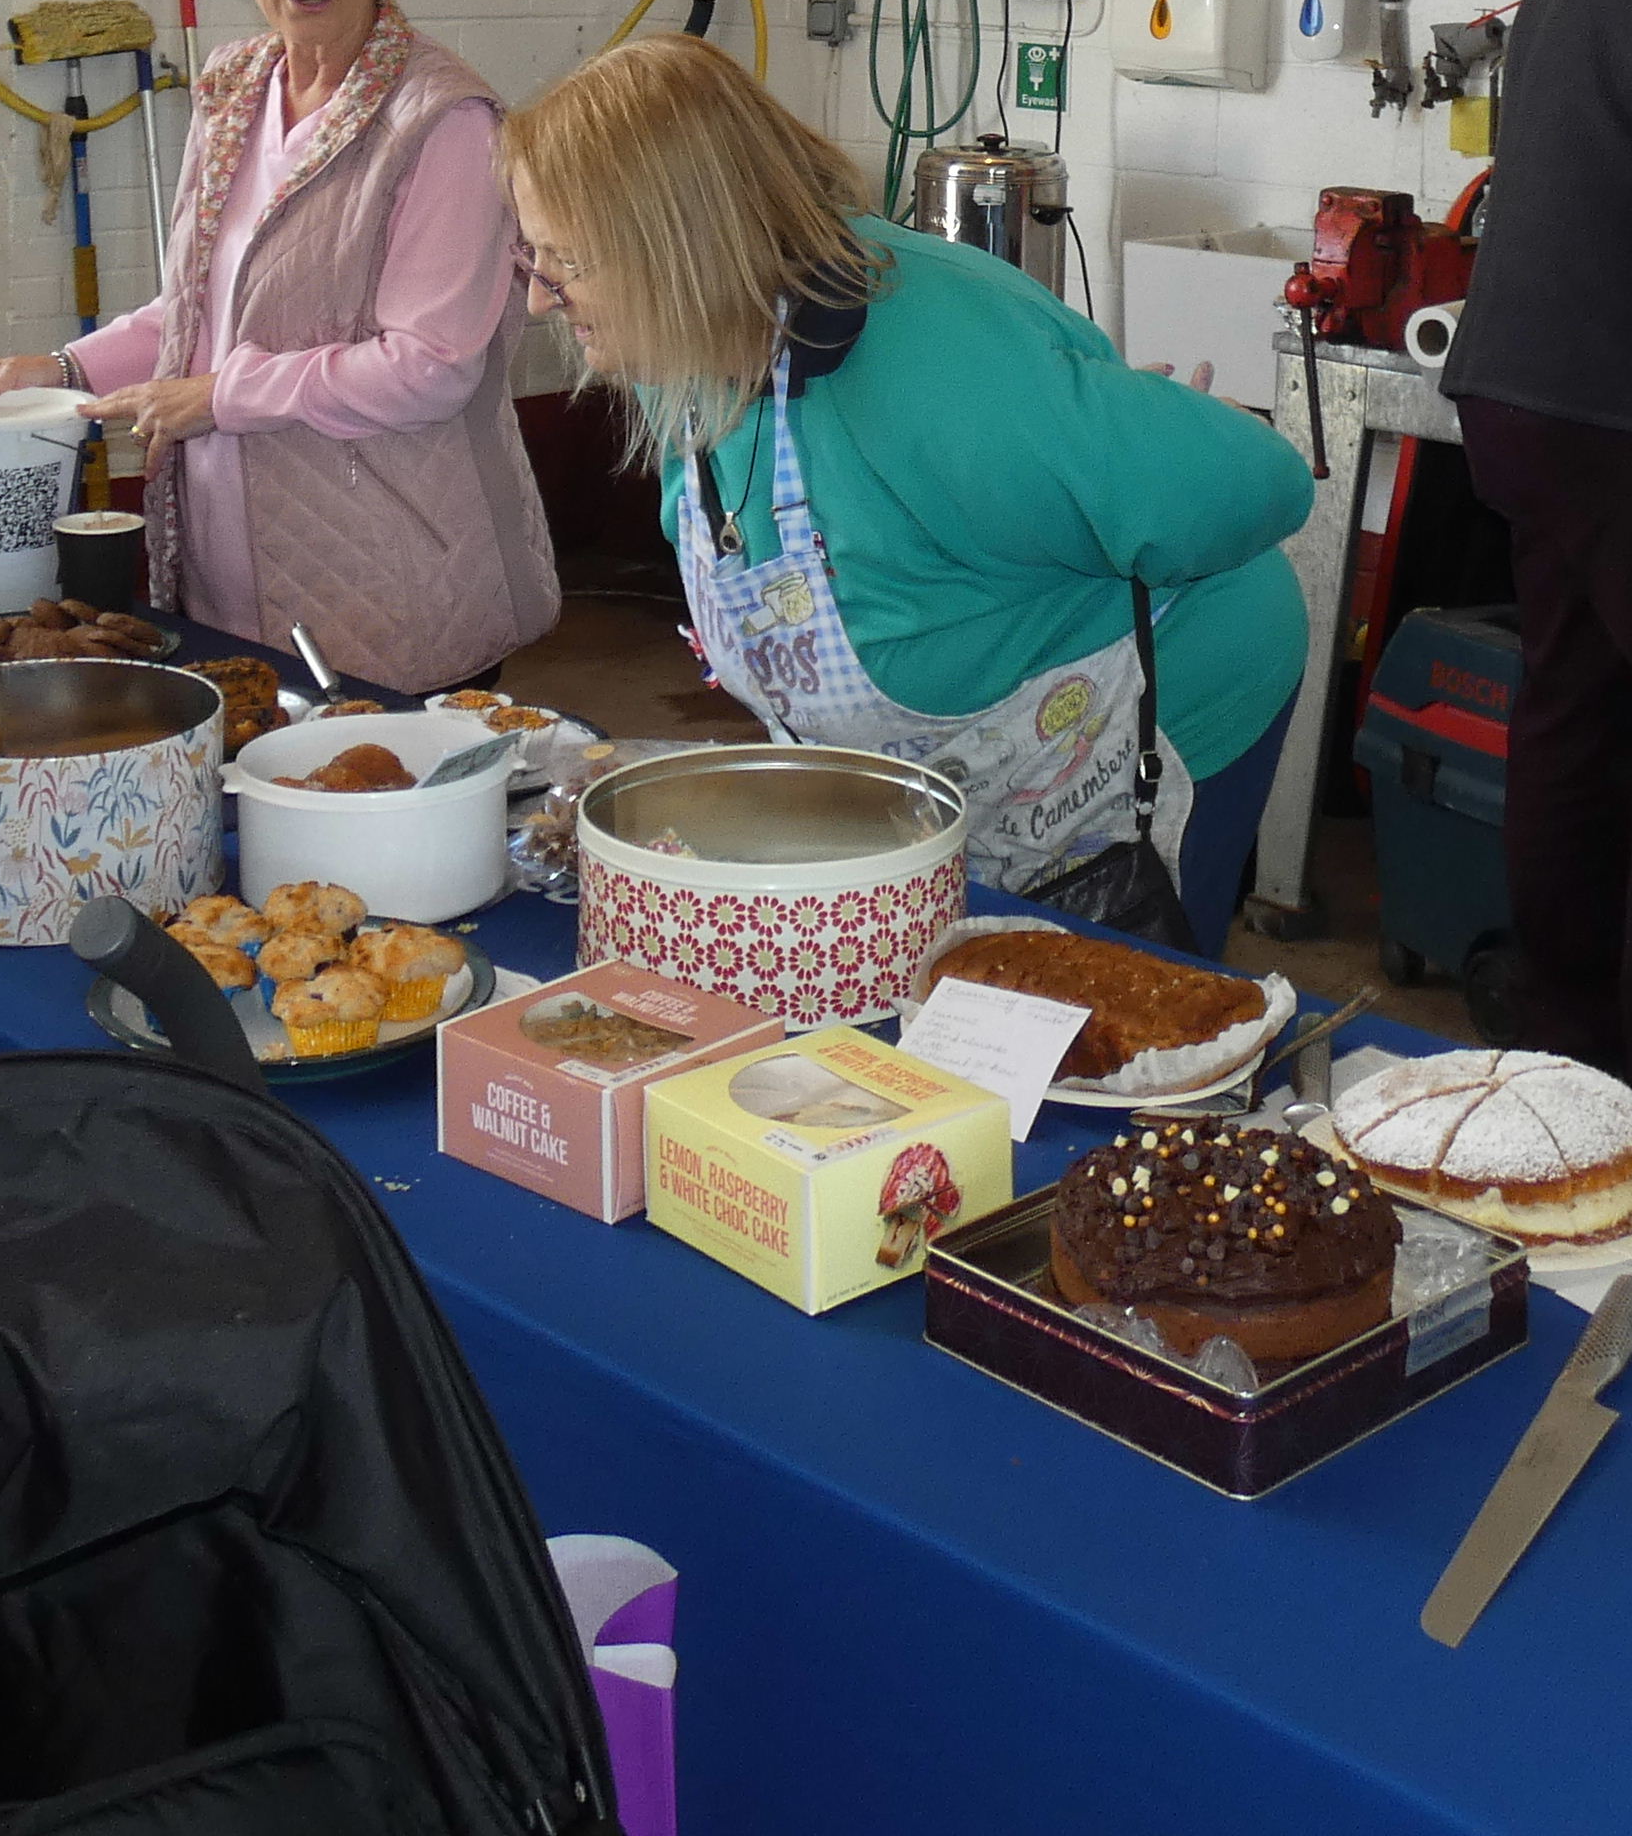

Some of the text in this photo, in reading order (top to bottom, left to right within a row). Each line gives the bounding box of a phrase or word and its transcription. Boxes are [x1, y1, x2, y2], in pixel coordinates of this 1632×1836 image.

[1431, 660, 1509, 710] BOSCH
[1030, 740, 1135, 841] Camembert
[471, 1103, 528, 1149] WALNUT
[530, 1130, 569, 1166] CAKE
[486, 1081, 538, 1125] COFFEE
[540, 1104, 551, 1130] &
[659, 1133, 788, 1226] LEMON, RASPBERRY
[660, 1164, 668, 1190] &
[671, 1172, 711, 1215] WHITE
[714, 1195, 750, 1237] CHOC
[752, 1216, 790, 1260] CAKE
